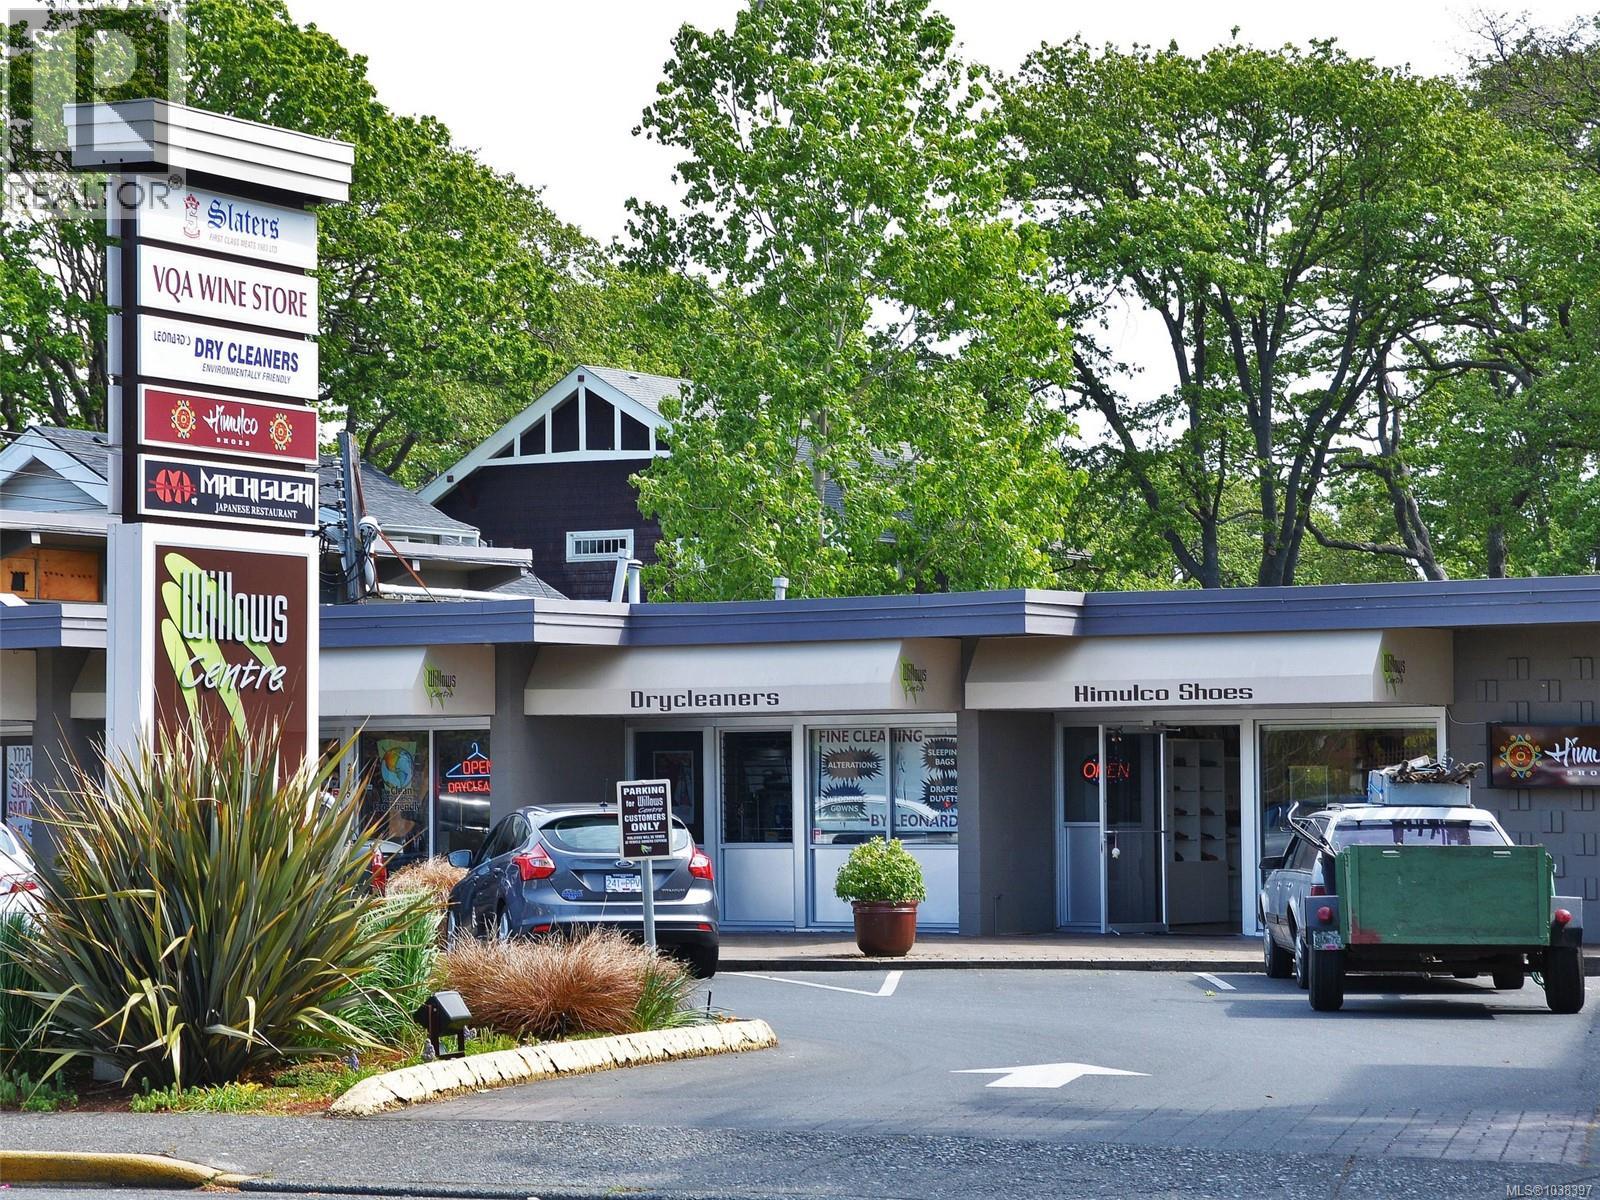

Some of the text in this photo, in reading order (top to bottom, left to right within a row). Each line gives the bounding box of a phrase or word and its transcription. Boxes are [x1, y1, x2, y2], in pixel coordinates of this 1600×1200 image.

[208, 199, 280, 240] Slaters
[153, 265, 307, 318] VQA WINE STORE
[195, 337, 223, 361] DRY
[228, 342, 299, 372] CLEANERS
[202, 362, 291, 384] ENVIRONMENTALLY FRIENDLY
[203, 404, 258, 438] Himulco
[217, 437, 250, 446] SHOES
[215, 502, 298, 519] JAPANESE RESTAURANT
[182, 569, 288, 643] Willows
[182, 655, 287, 691] Centre
[630, 690, 780, 711] Drycleaners
[1074, 683, 1253, 702] Himulco Shoes
[819, 730, 849, 743] FINE
[1544, 736, 1600, 767] Himu
[935, 758, 955, 766] BAGS
[448, 780, 491, 793] DRYCLEA
[623, 786, 665, 795] PARKING
[626, 795, 663, 808] for Willows
[624, 813, 666, 822] CUSTOMERS
[631, 822, 660, 831] ONLY
[871, 814, 887, 827] BY
